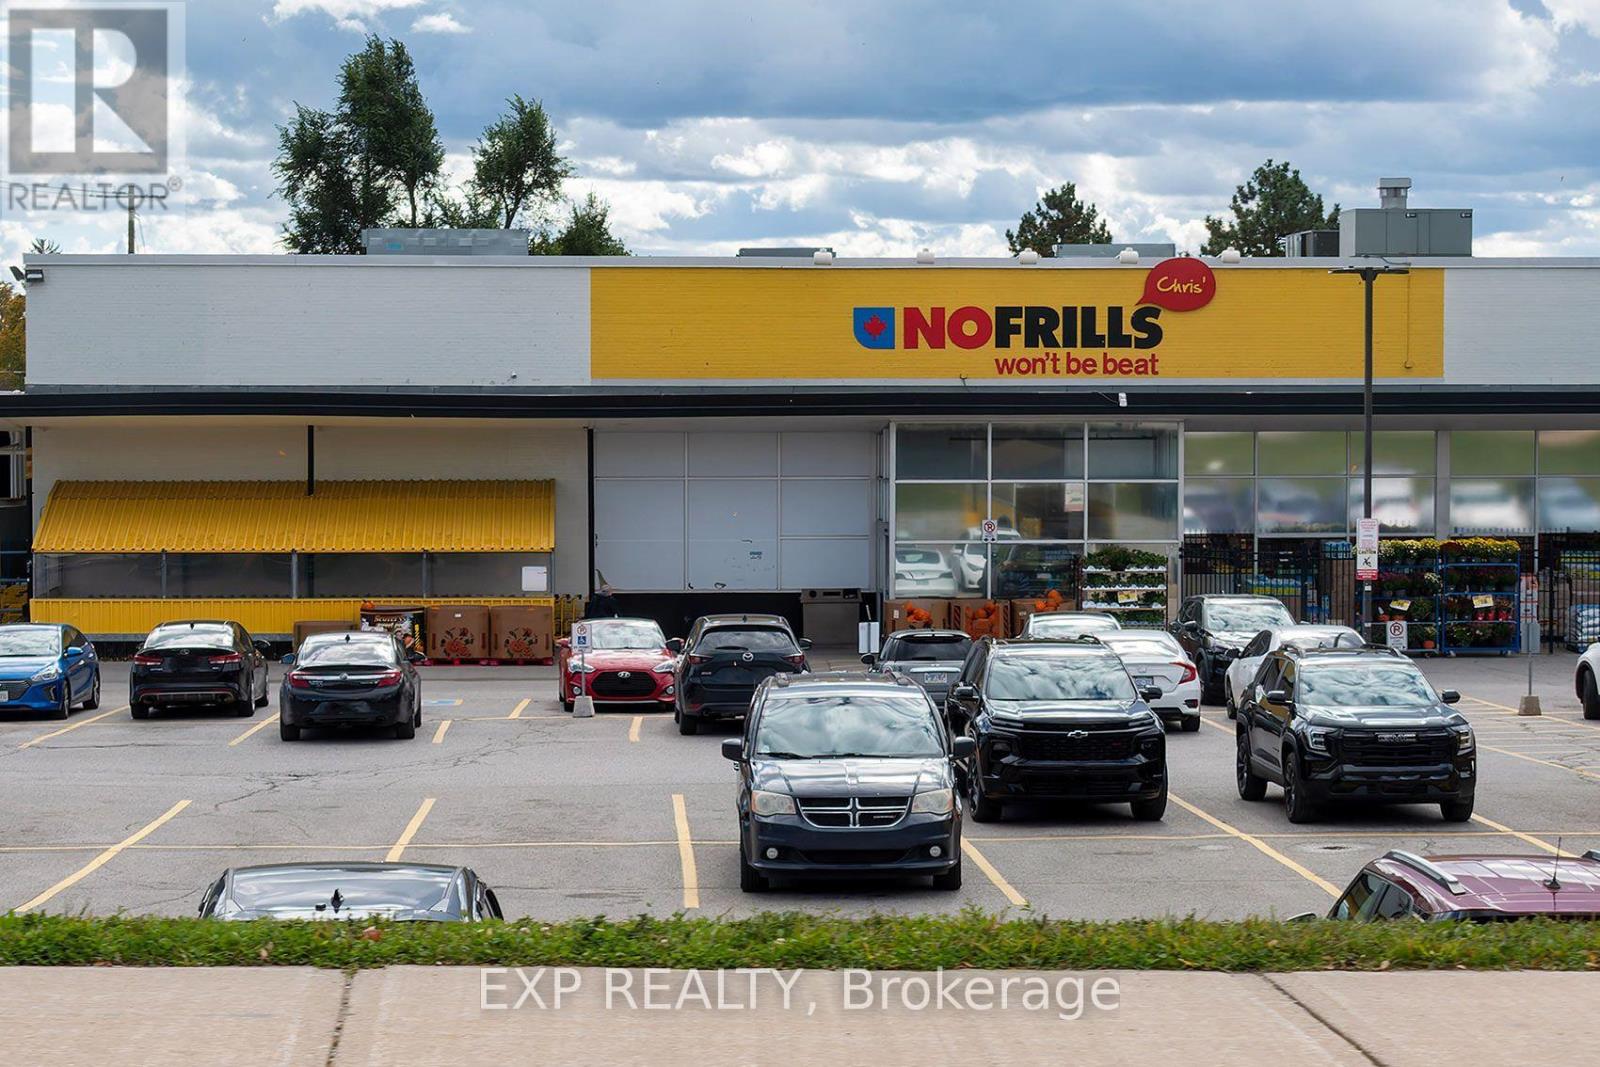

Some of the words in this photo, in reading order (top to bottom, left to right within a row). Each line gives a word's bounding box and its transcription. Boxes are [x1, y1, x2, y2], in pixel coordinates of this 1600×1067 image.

[995, 353, 1061, 375] won't
[1066, 353, 1097, 375] be
[1103, 353, 1159, 375] beat
